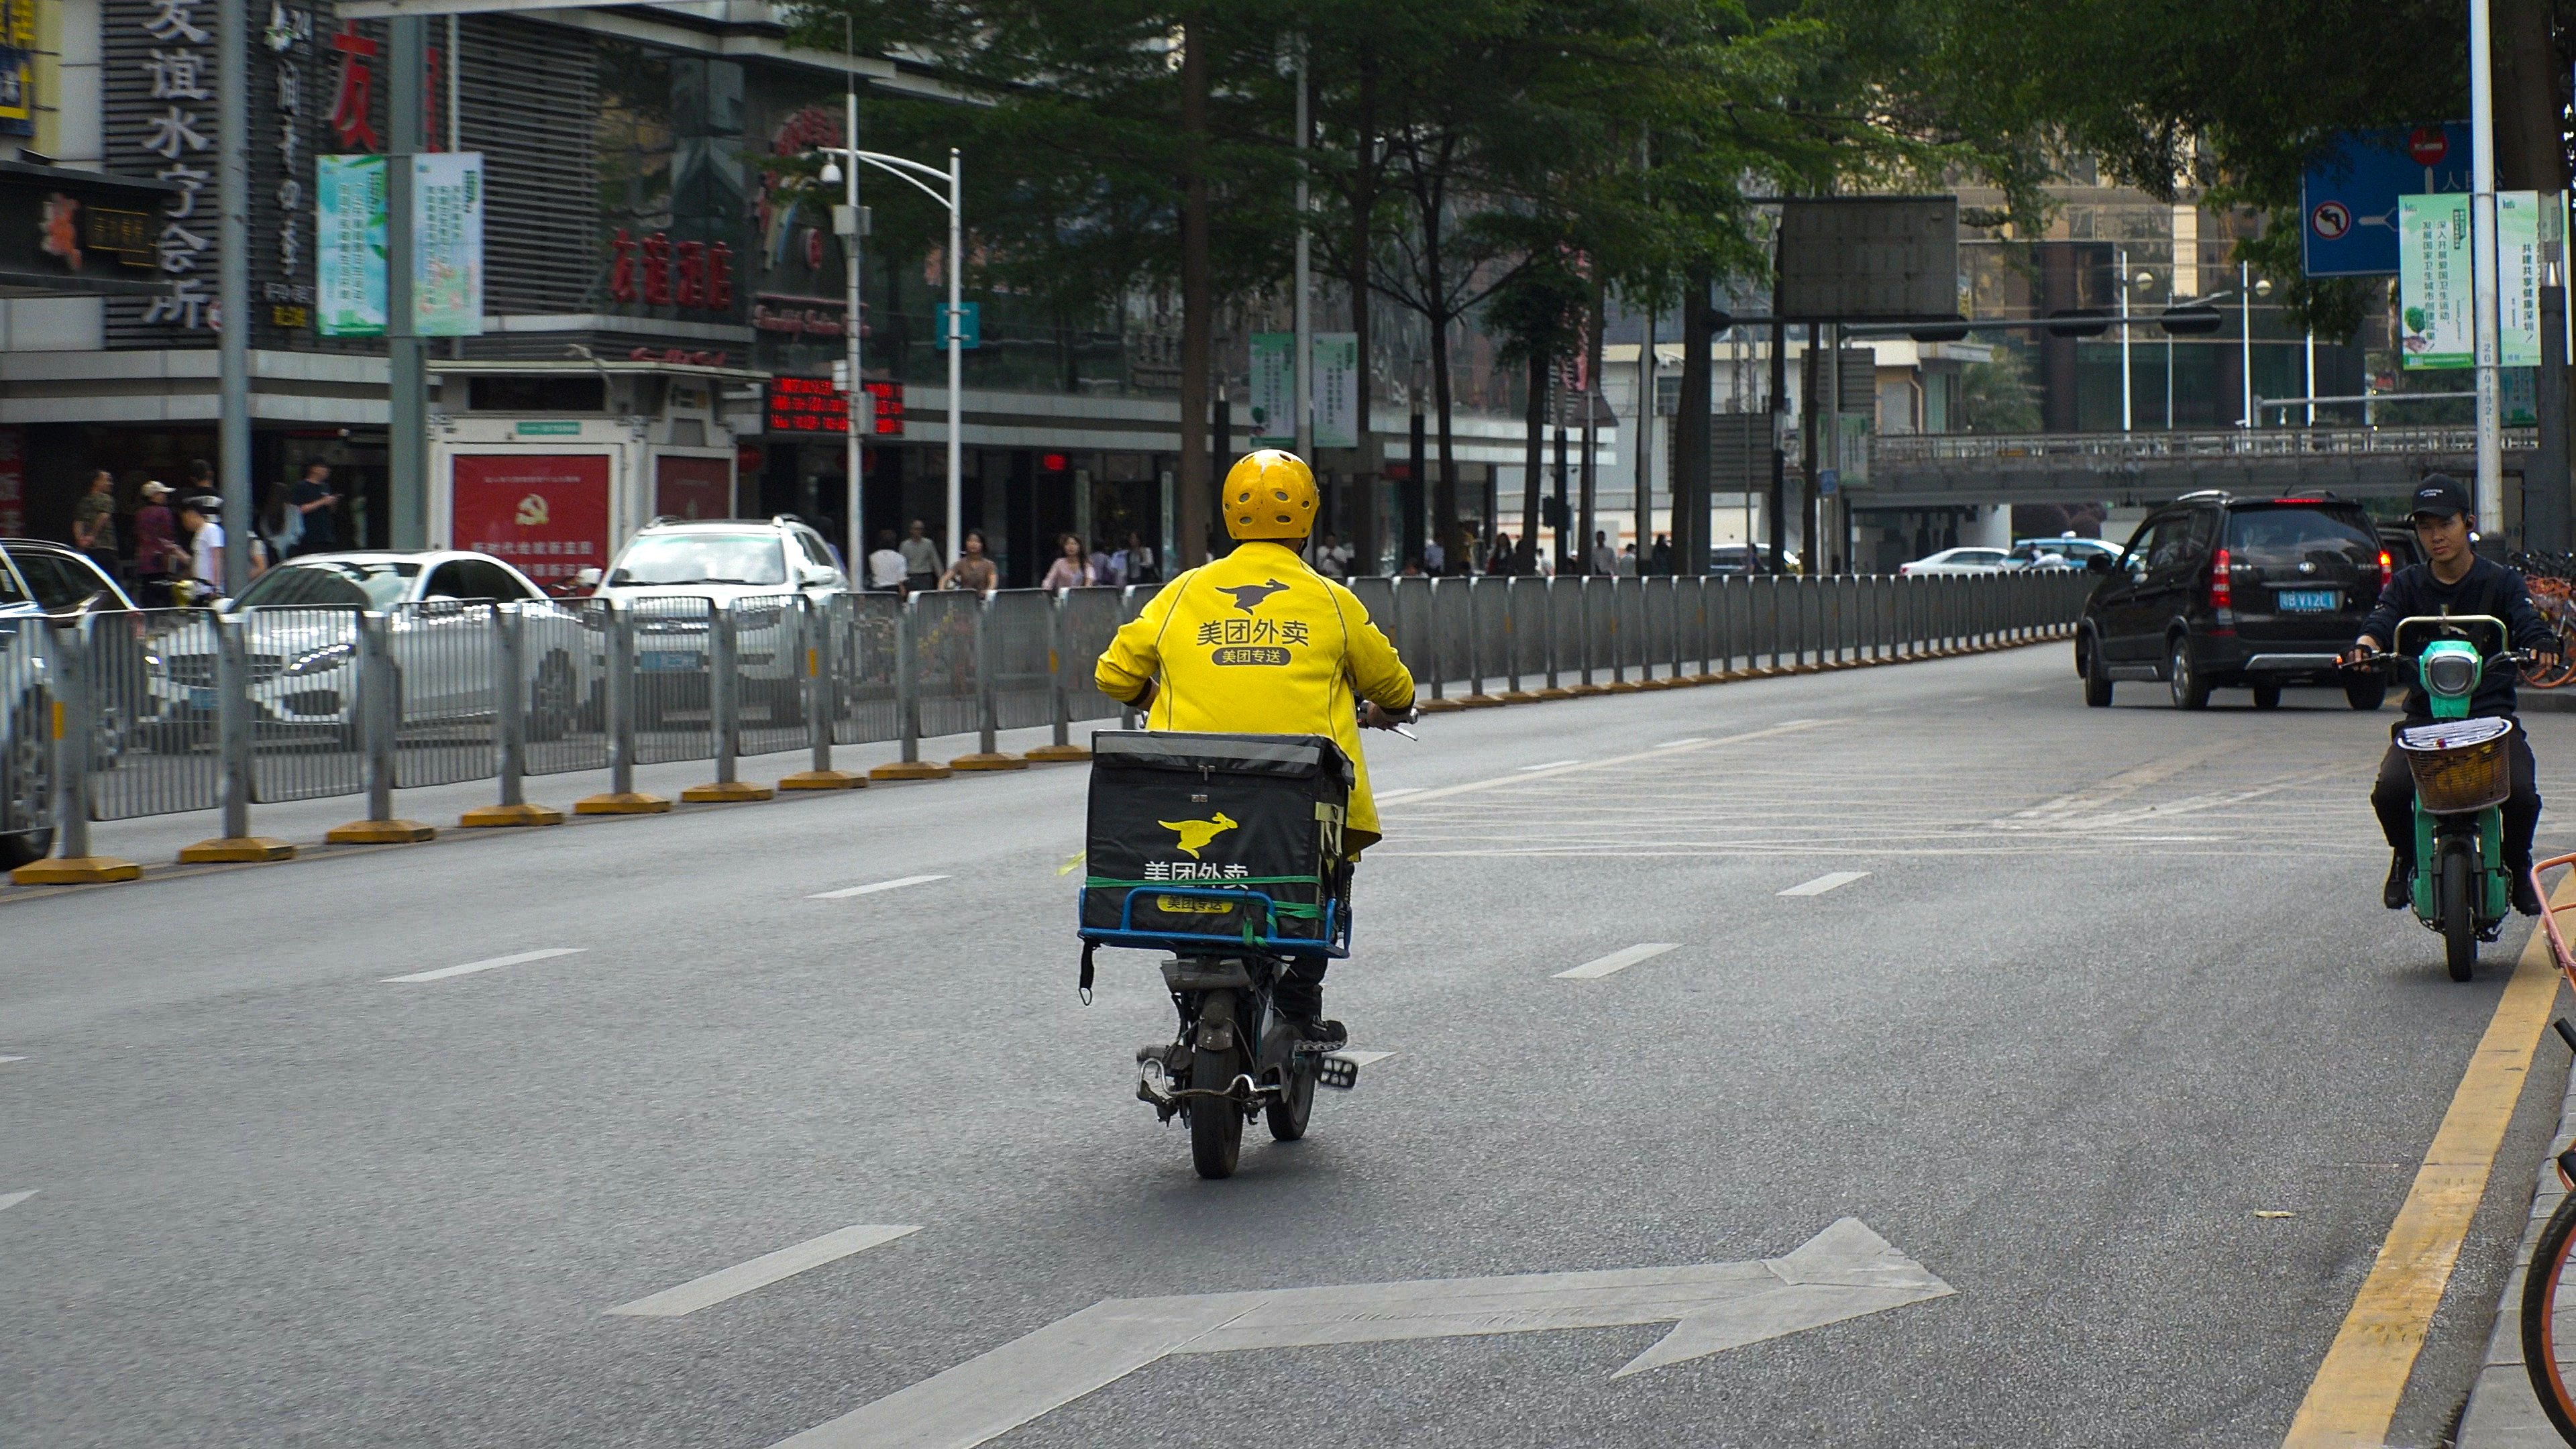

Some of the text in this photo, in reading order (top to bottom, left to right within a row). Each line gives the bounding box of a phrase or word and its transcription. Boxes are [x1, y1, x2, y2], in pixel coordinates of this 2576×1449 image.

[1197, 619, 1309, 647] 美团外卖
[1222, 649, 1281, 663] 美团专送
[1144, 861, 1248, 890] 美团外卖
